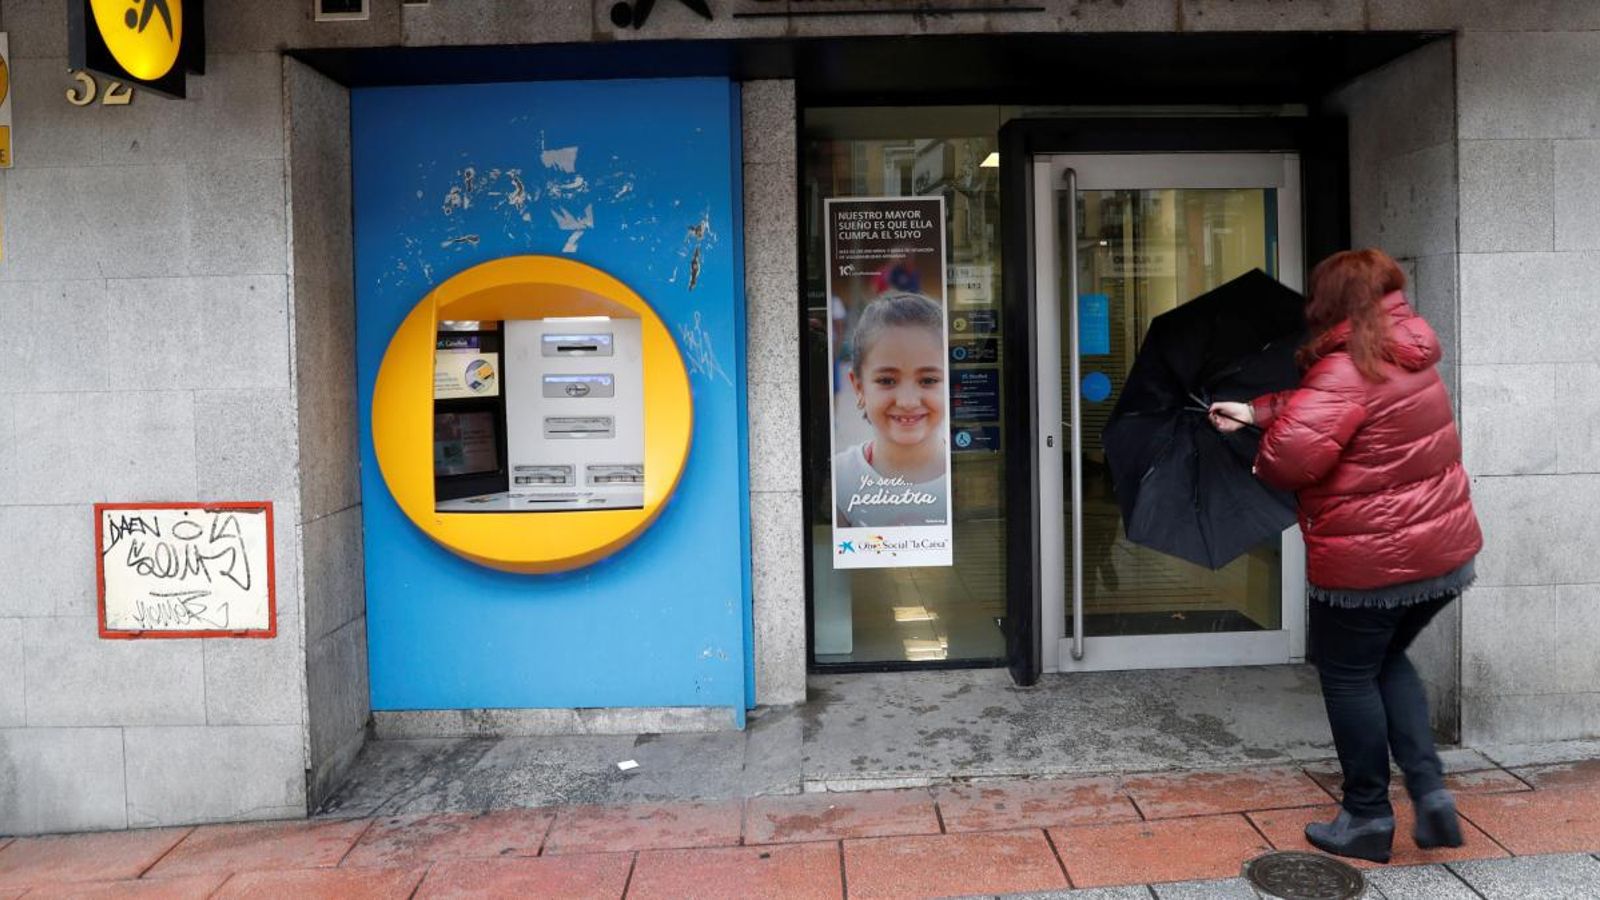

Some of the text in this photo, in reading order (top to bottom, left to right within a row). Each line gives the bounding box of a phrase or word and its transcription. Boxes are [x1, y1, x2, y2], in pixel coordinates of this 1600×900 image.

[838, 210, 921, 220] NUESTRO MAYOR
[838, 220, 933, 230] SUEÑO ES QUE ELLA
[838, 230, 921, 240] CUMPLA EL SUYO
[860, 474, 875, 491] Yo
[847, 488, 937, 512] pediatra
[882, 540, 908, 550] Social
